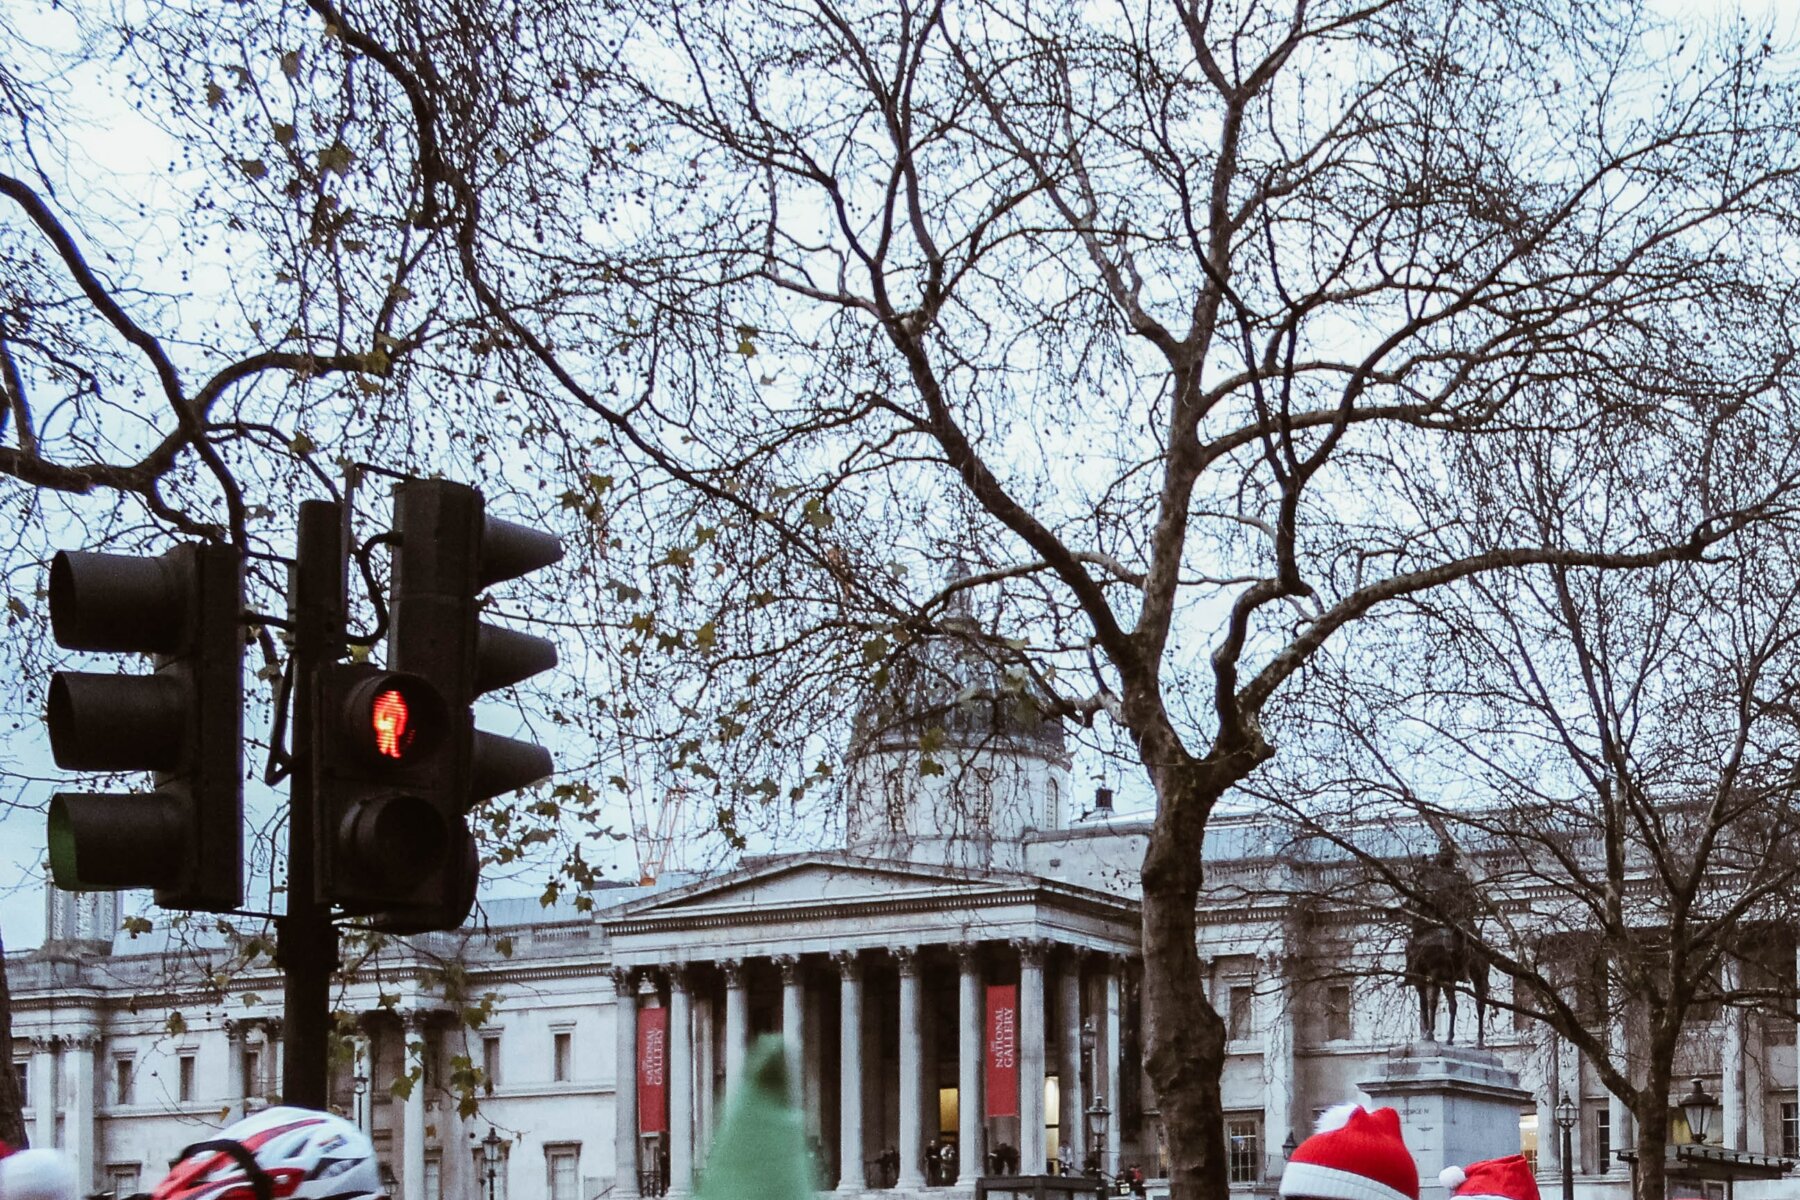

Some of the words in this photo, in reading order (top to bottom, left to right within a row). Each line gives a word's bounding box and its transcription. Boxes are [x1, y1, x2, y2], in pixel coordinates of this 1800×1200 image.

[654, 1029, 663, 1086] GALLERY
[995, 1008, 1004, 1068] NATIONAL
[1004, 1007, 1014, 1068] GALLERY
